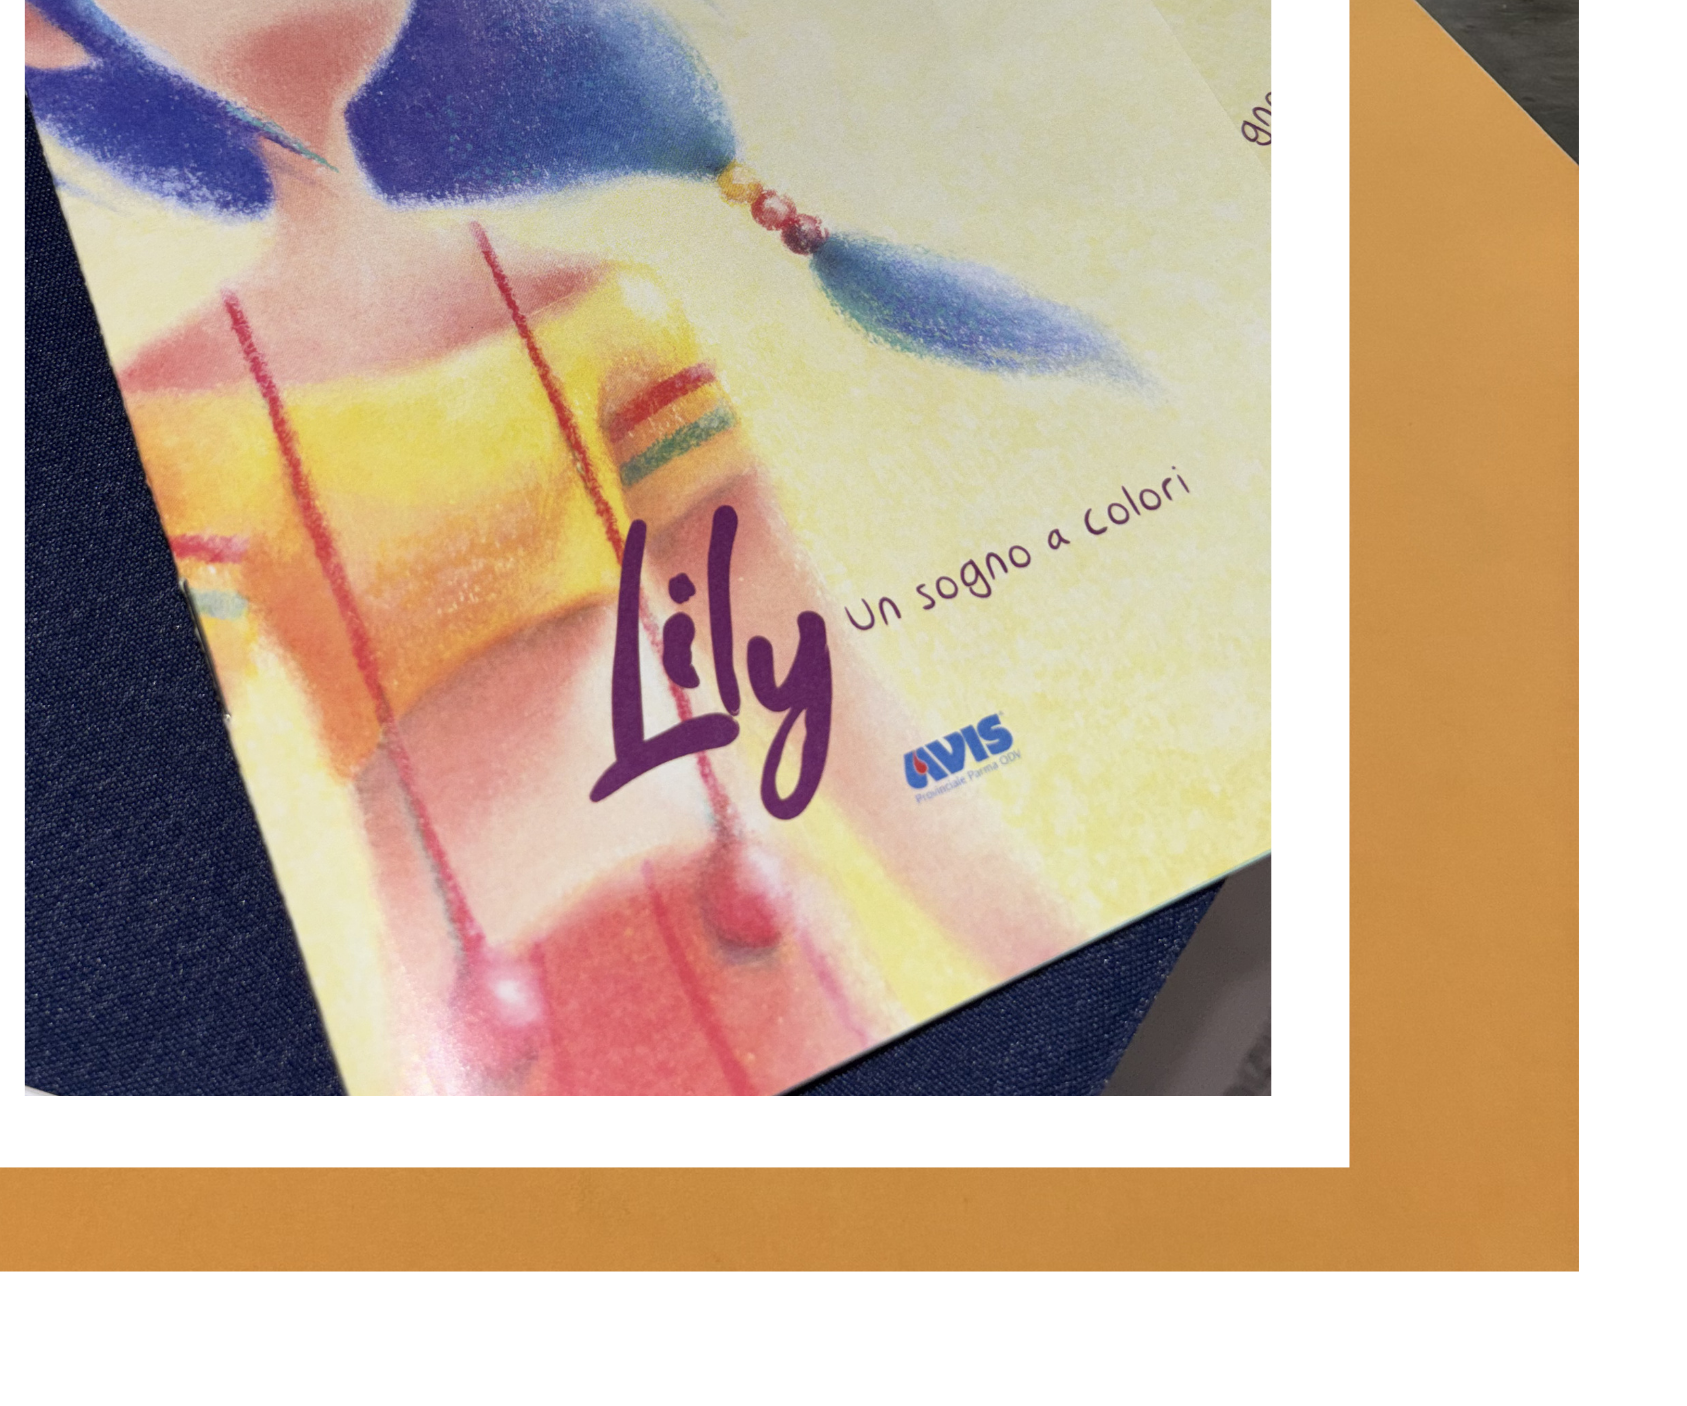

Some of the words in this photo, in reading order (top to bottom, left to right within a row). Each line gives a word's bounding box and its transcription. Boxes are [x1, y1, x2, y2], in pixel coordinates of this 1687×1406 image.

[916, 545, 1031, 610] sogno
[1048, 528, 1071, 550] a
[589, 505, 832, 820] Lily
[903, 713, 1014, 789] AVIS
[915, 775, 967, 803] Provinciale
[967, 761, 999, 782] Parma
